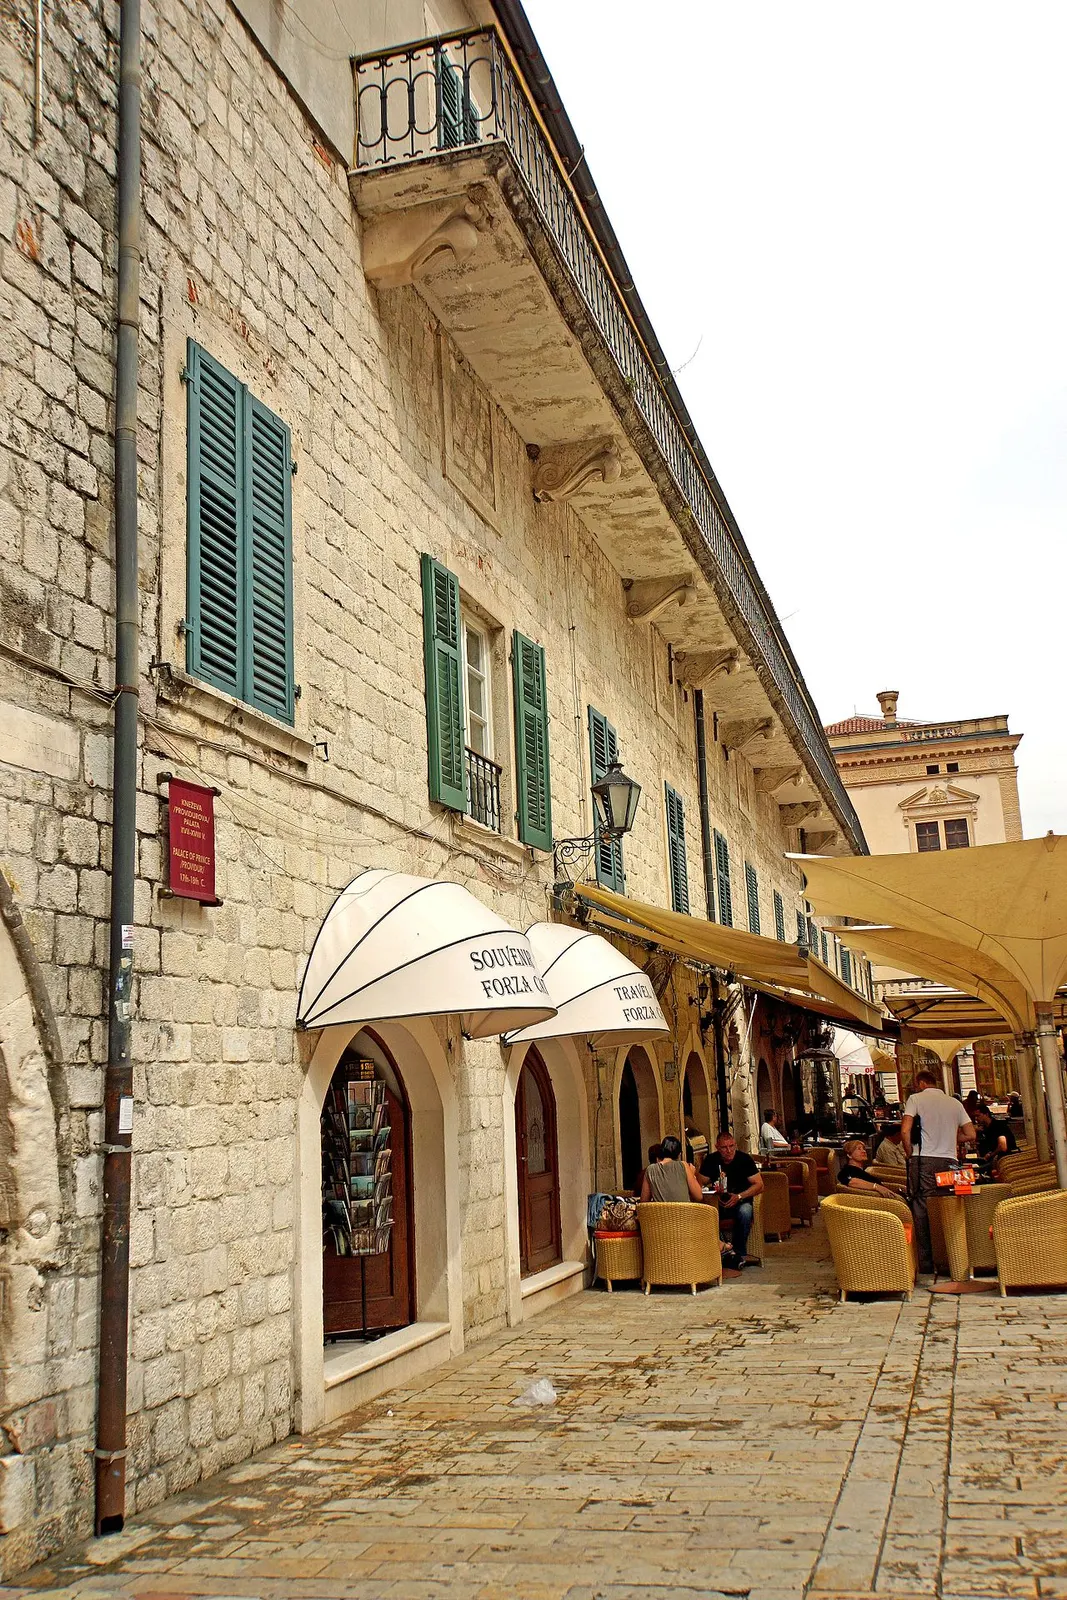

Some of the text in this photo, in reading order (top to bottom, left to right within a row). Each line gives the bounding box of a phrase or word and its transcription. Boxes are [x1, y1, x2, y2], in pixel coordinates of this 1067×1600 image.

[183, 818, 200, 829] PALATA
[172, 847, 210, 865] PALACE OF PRINCE
[481, 976, 533, 998] FORZA
[613, 983, 652, 1000] TRAVEL
[622, 1006, 657, 1022] FORZA
